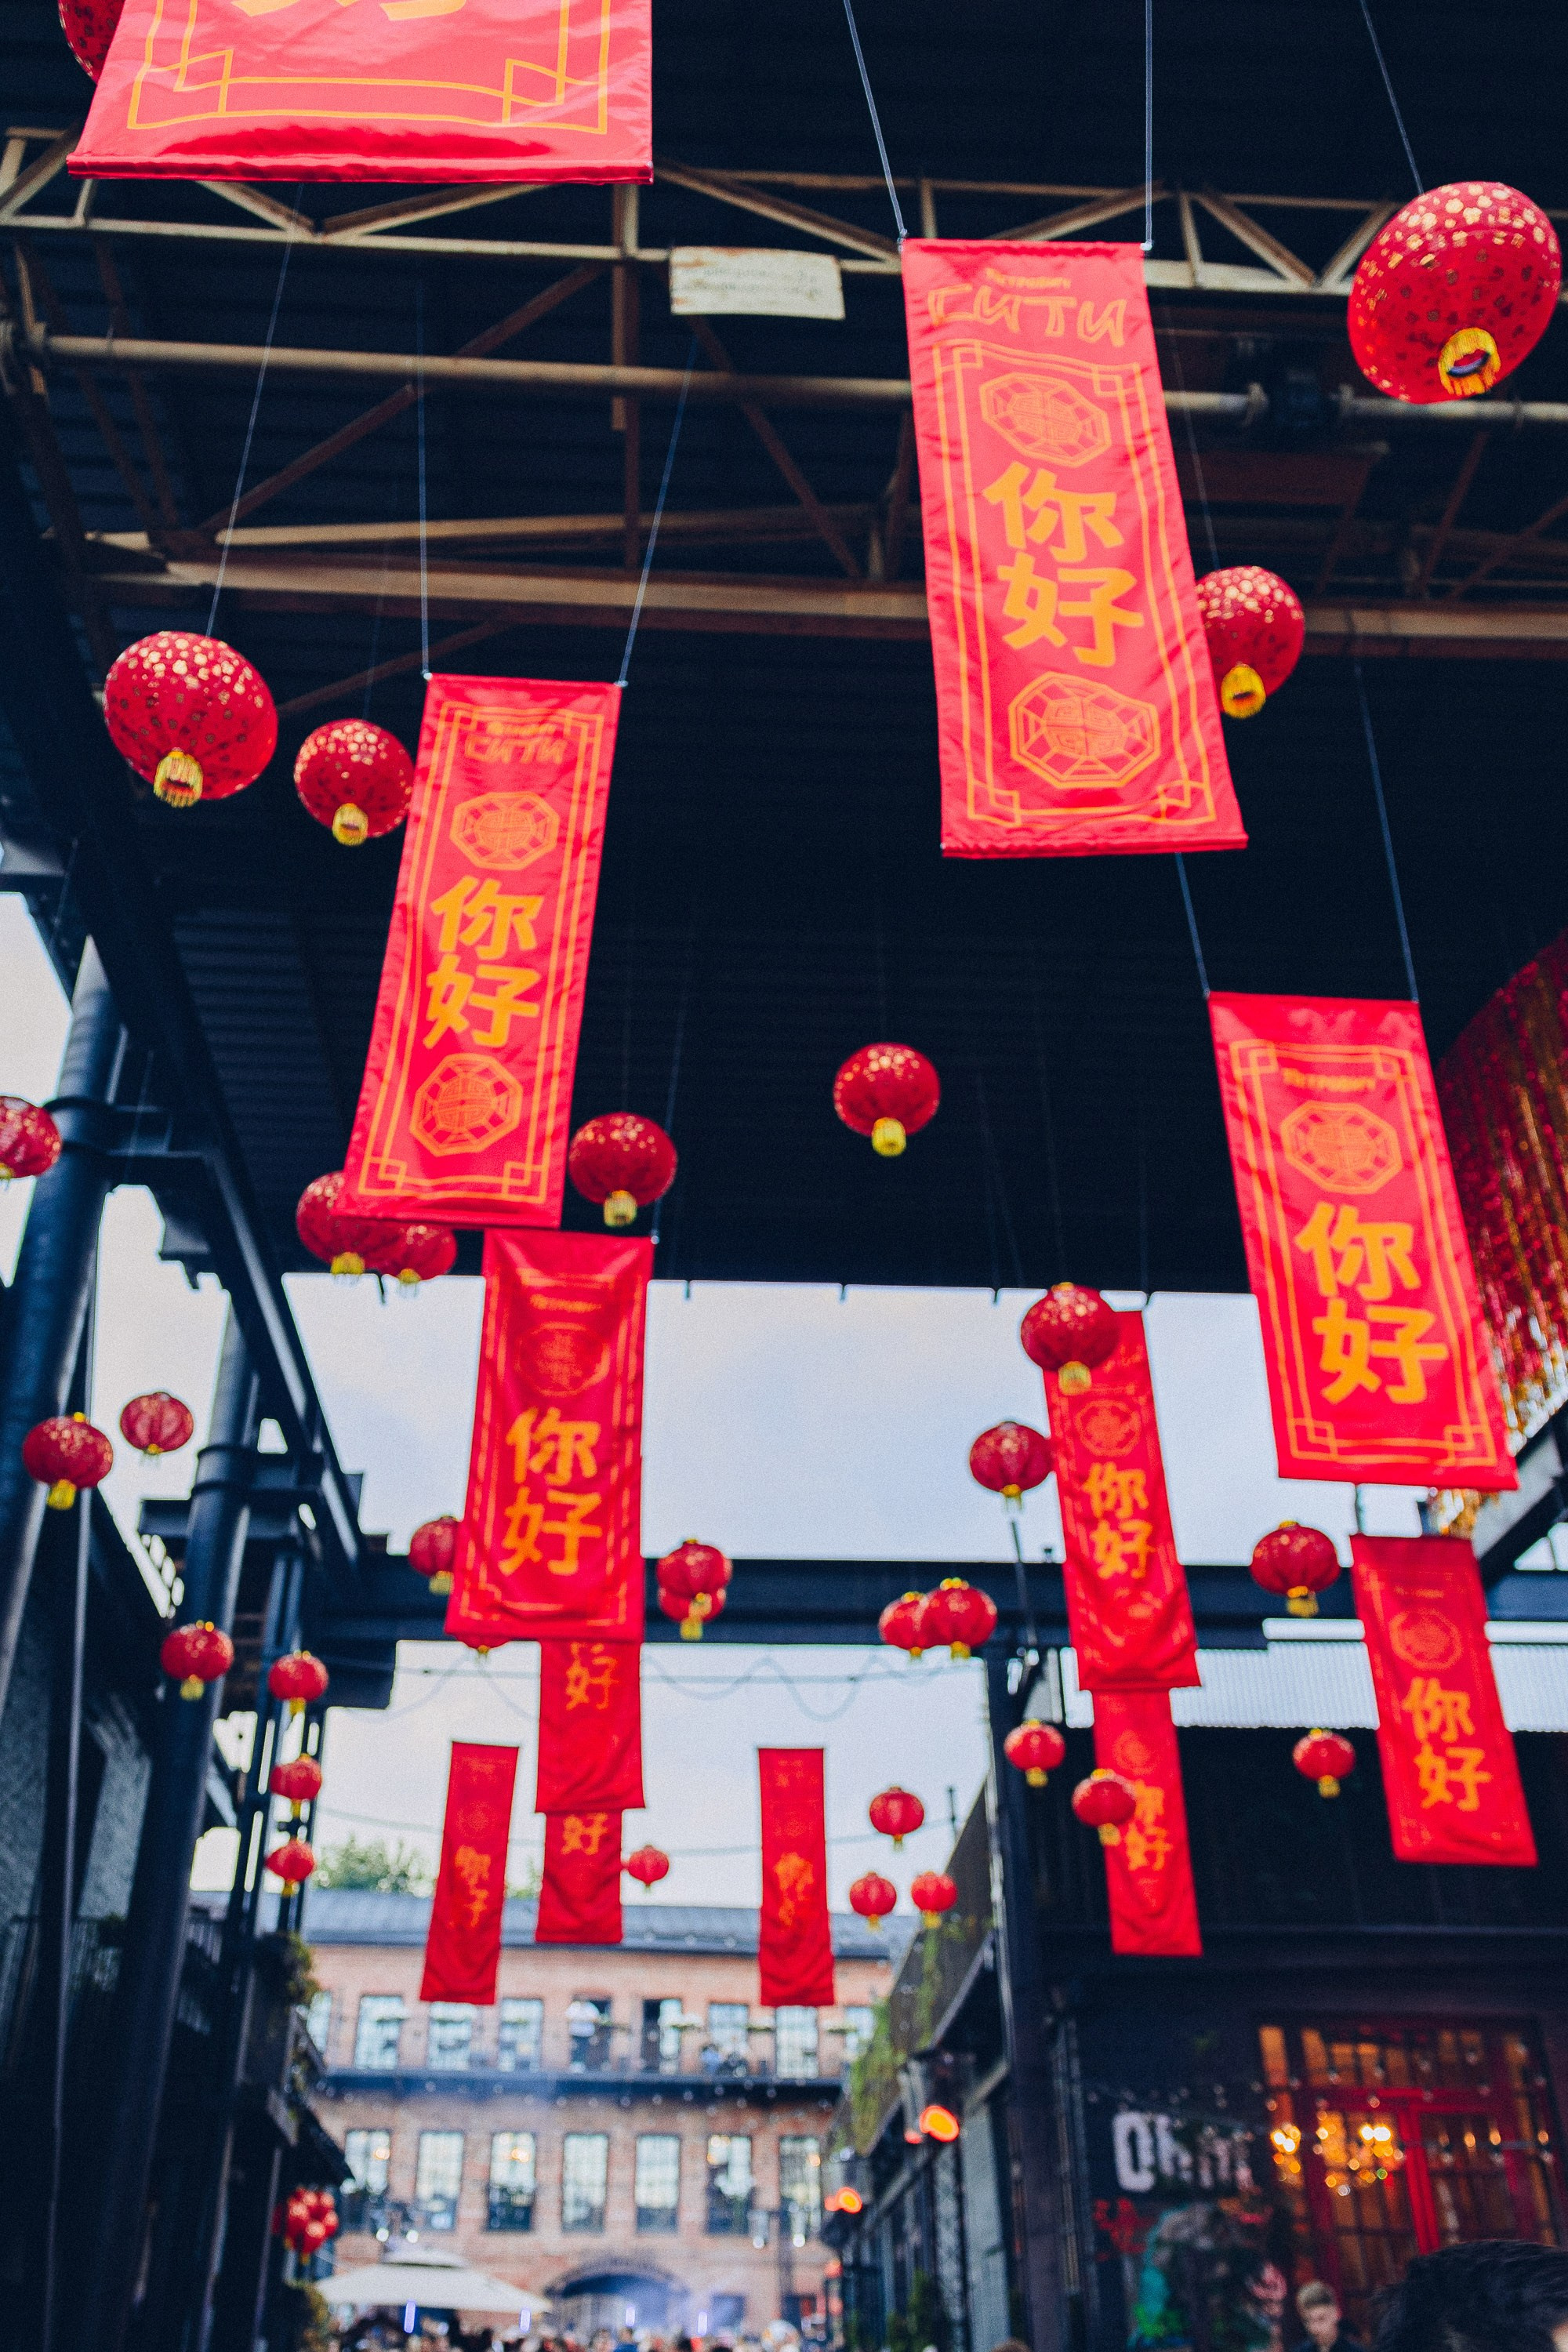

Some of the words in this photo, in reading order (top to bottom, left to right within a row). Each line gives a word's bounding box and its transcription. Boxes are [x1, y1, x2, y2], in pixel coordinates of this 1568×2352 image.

[981, 461, 1145, 667] 你好
[423, 874, 544, 1049] 你好
[1294, 1201, 1449, 1405] 你好
[499, 1406, 603, 1576] 你好
[1082, 1461, 1156, 1580] 你好
[1402, 1677, 1492, 1812] 你好
